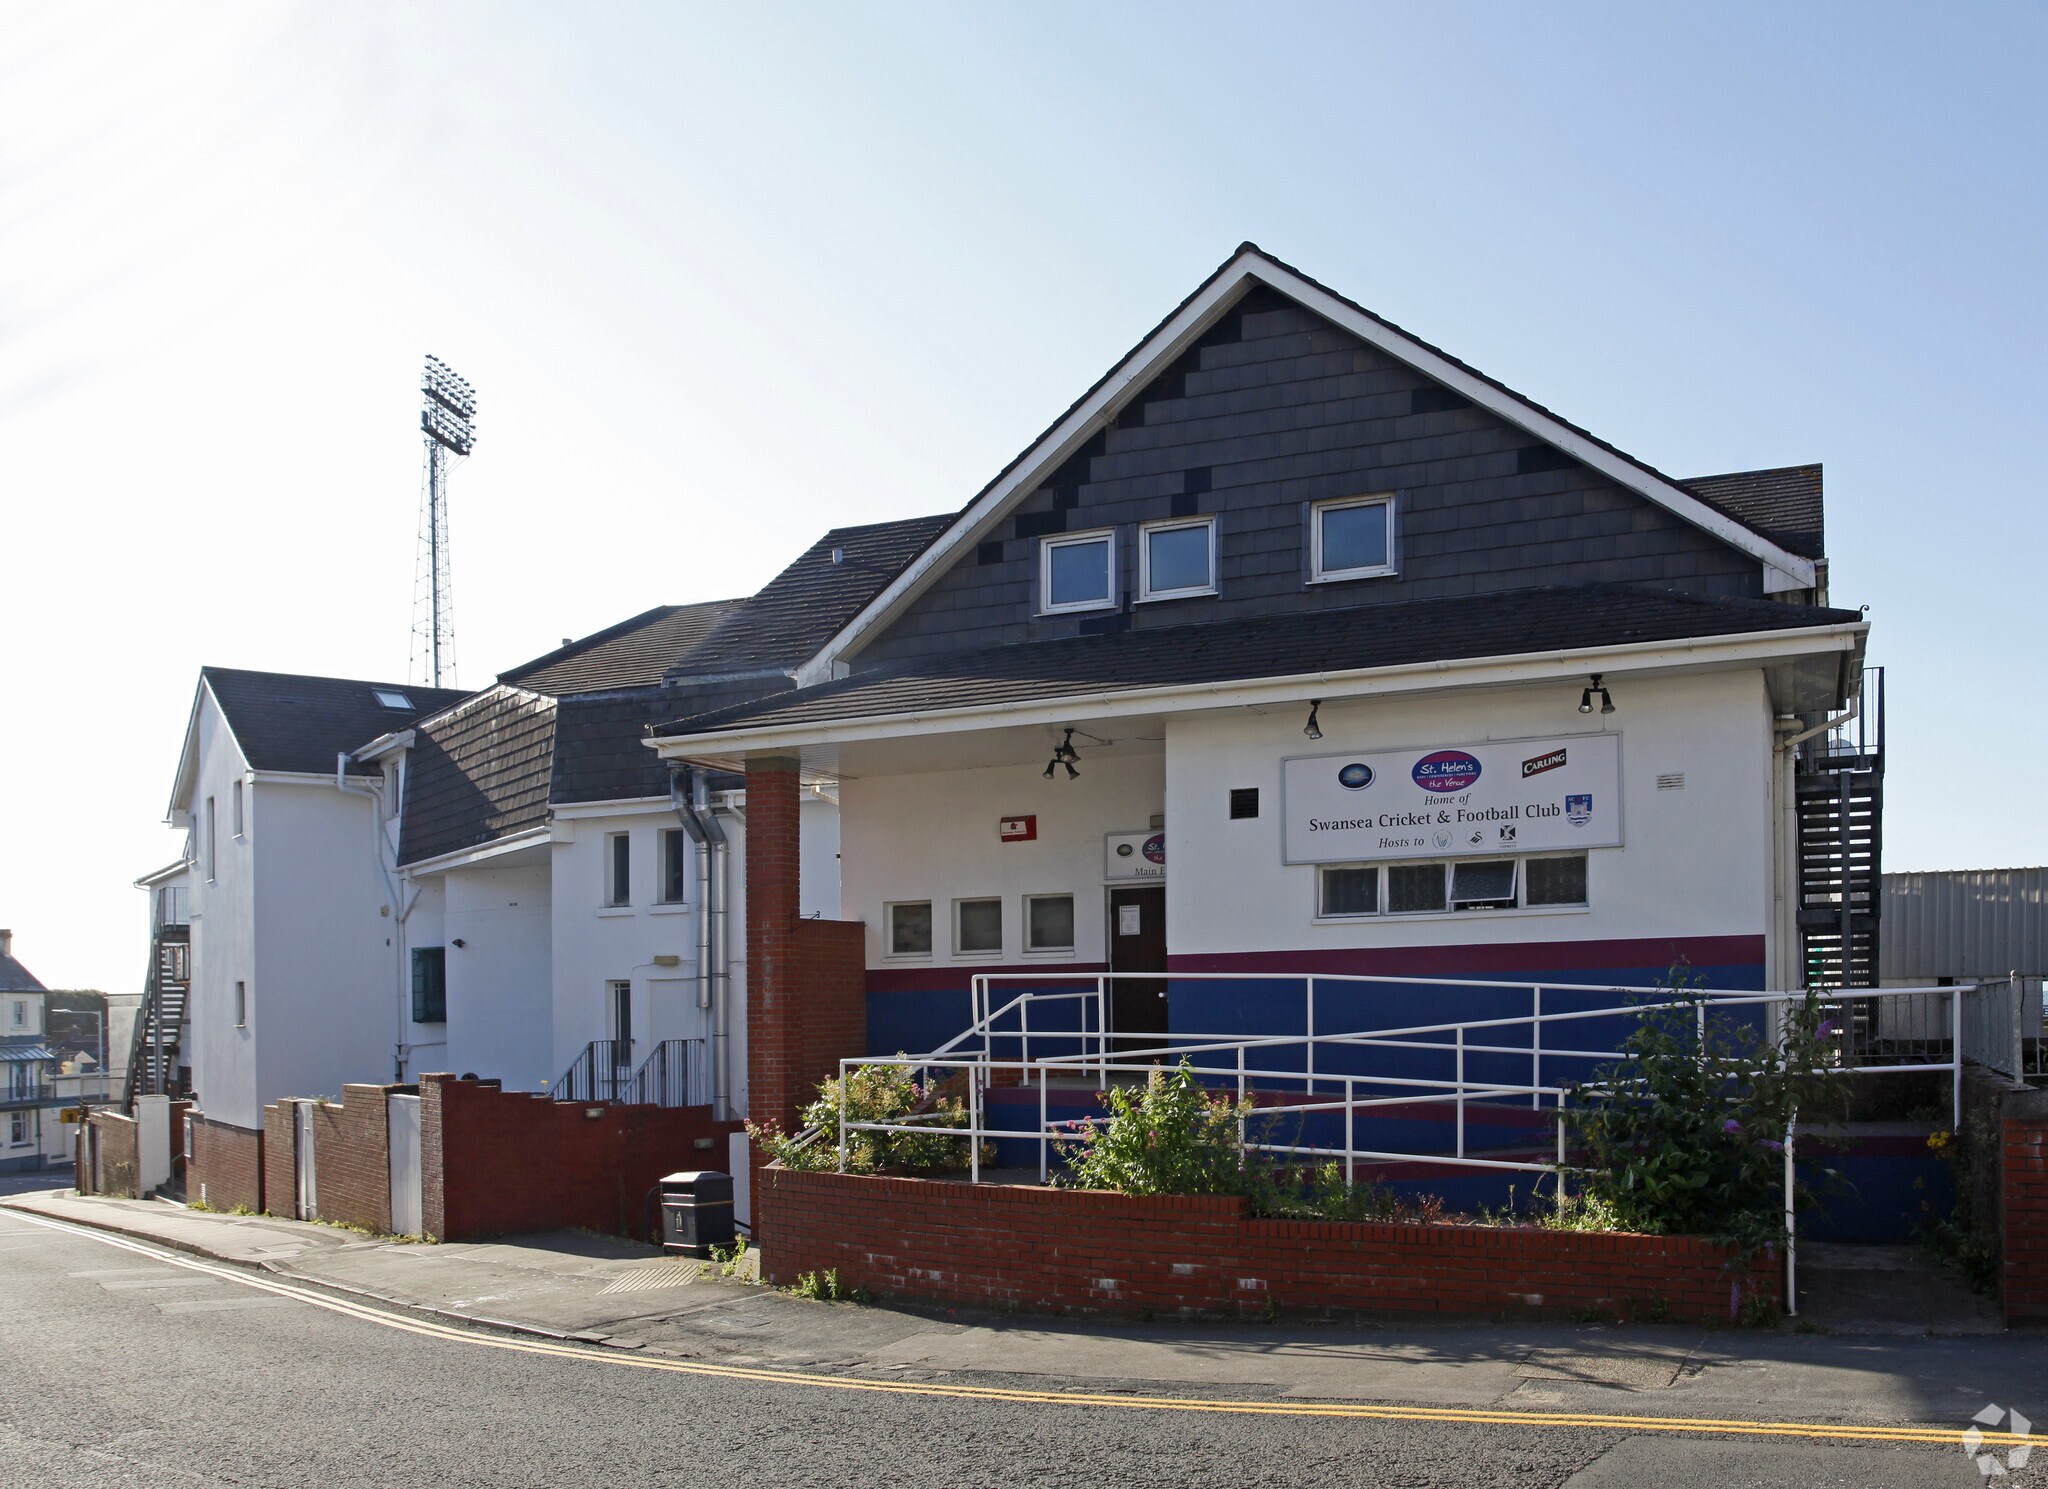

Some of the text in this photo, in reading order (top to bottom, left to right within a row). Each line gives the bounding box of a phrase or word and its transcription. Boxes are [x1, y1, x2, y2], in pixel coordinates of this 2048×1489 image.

[1420, 761, 1474, 774] St. Helen's
[1429, 777, 1466, 788] the Venue
[1424, 793, 1471, 806] Home of
[1309, 803, 1560, 832] Swansea Cricket & Football Club
[1148, 842, 1160, 850] St.
[1379, 837, 1425, 848] Hosts to
[1135, 867, 1157, 876] Main
